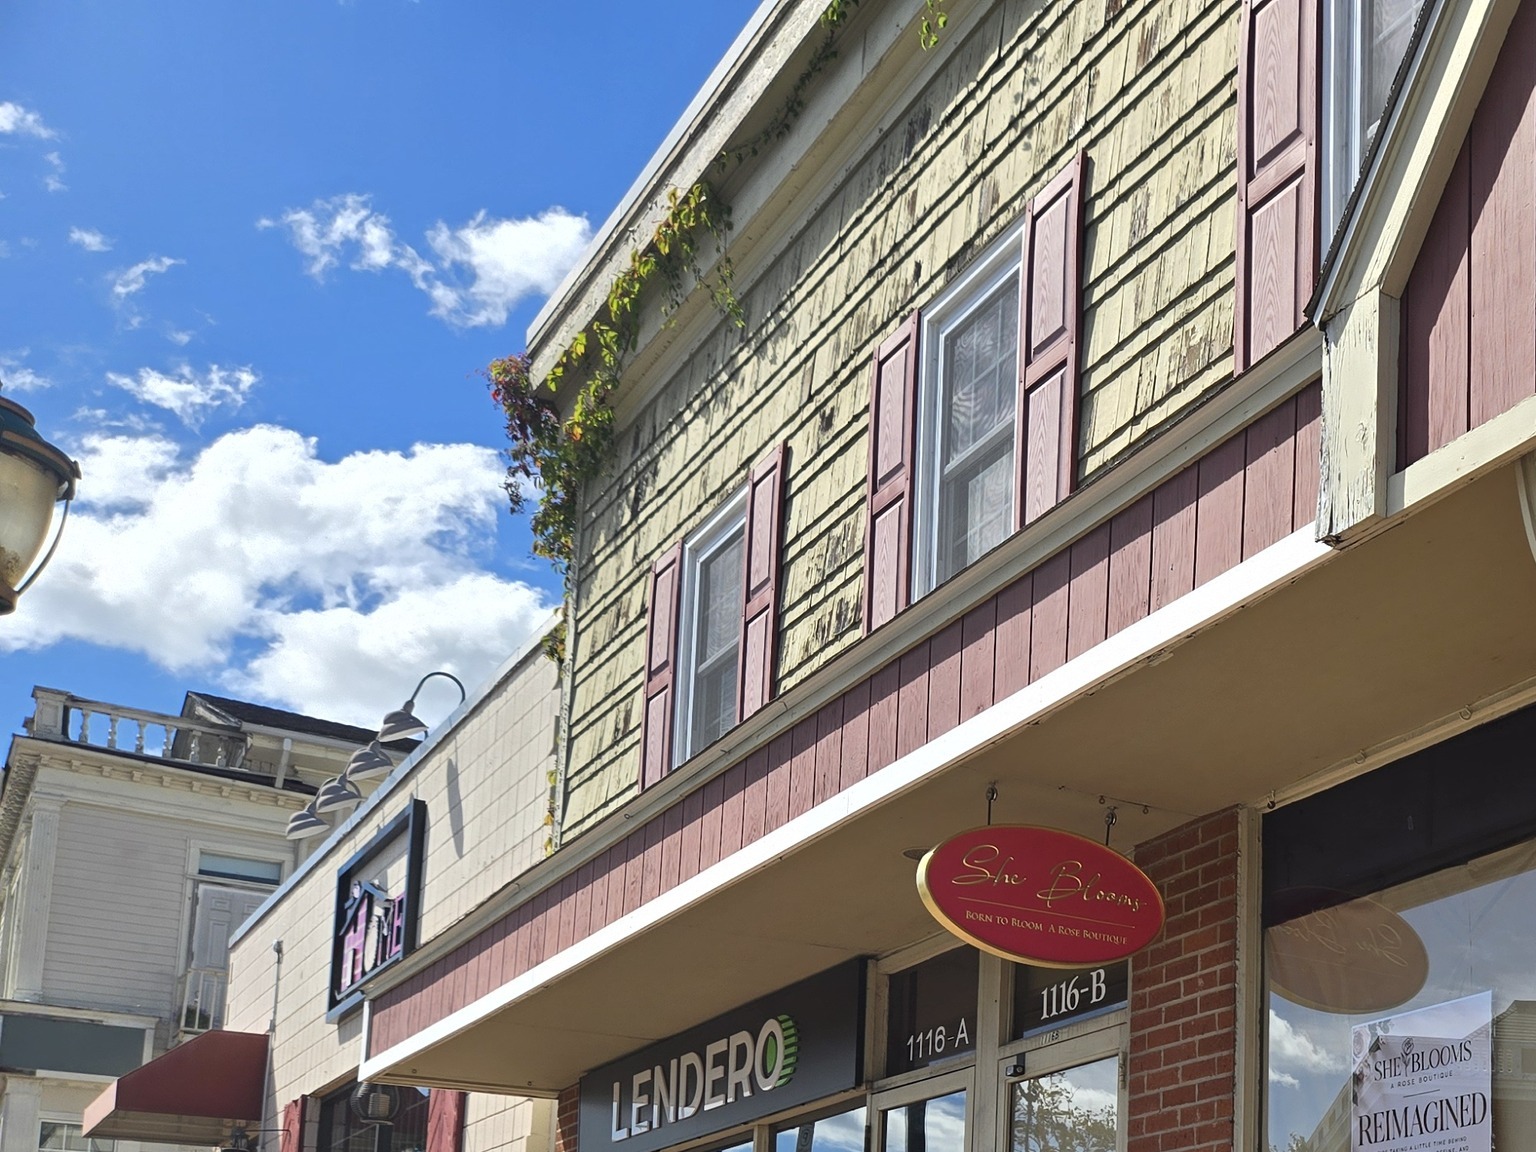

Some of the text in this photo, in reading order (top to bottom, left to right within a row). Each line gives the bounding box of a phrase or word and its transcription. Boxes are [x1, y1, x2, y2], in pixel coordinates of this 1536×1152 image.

[952, 844, 1147, 911] She Blooms
[966, 910, 1127, 945] BORN TO BLOOM A ROSE BOUTIQUE
[1040, 968, 1107, 1020] 1116-B
[907, 1017, 969, 1061] 1116-A
[1374, 1040, 1472, 1081] SHE BLOOMS
[612, 1018, 786, 1142] LENDERO
[1397, 1079, 1415, 1087] ROSE
[1419, 1070, 1453, 1083] BOUTIQUE
[1357, 1092, 1487, 1146] REIMAGINED
[1414, 1142, 1431, 1150] LITTLE
[1448, 1136, 1467, 1144] BEHIND
